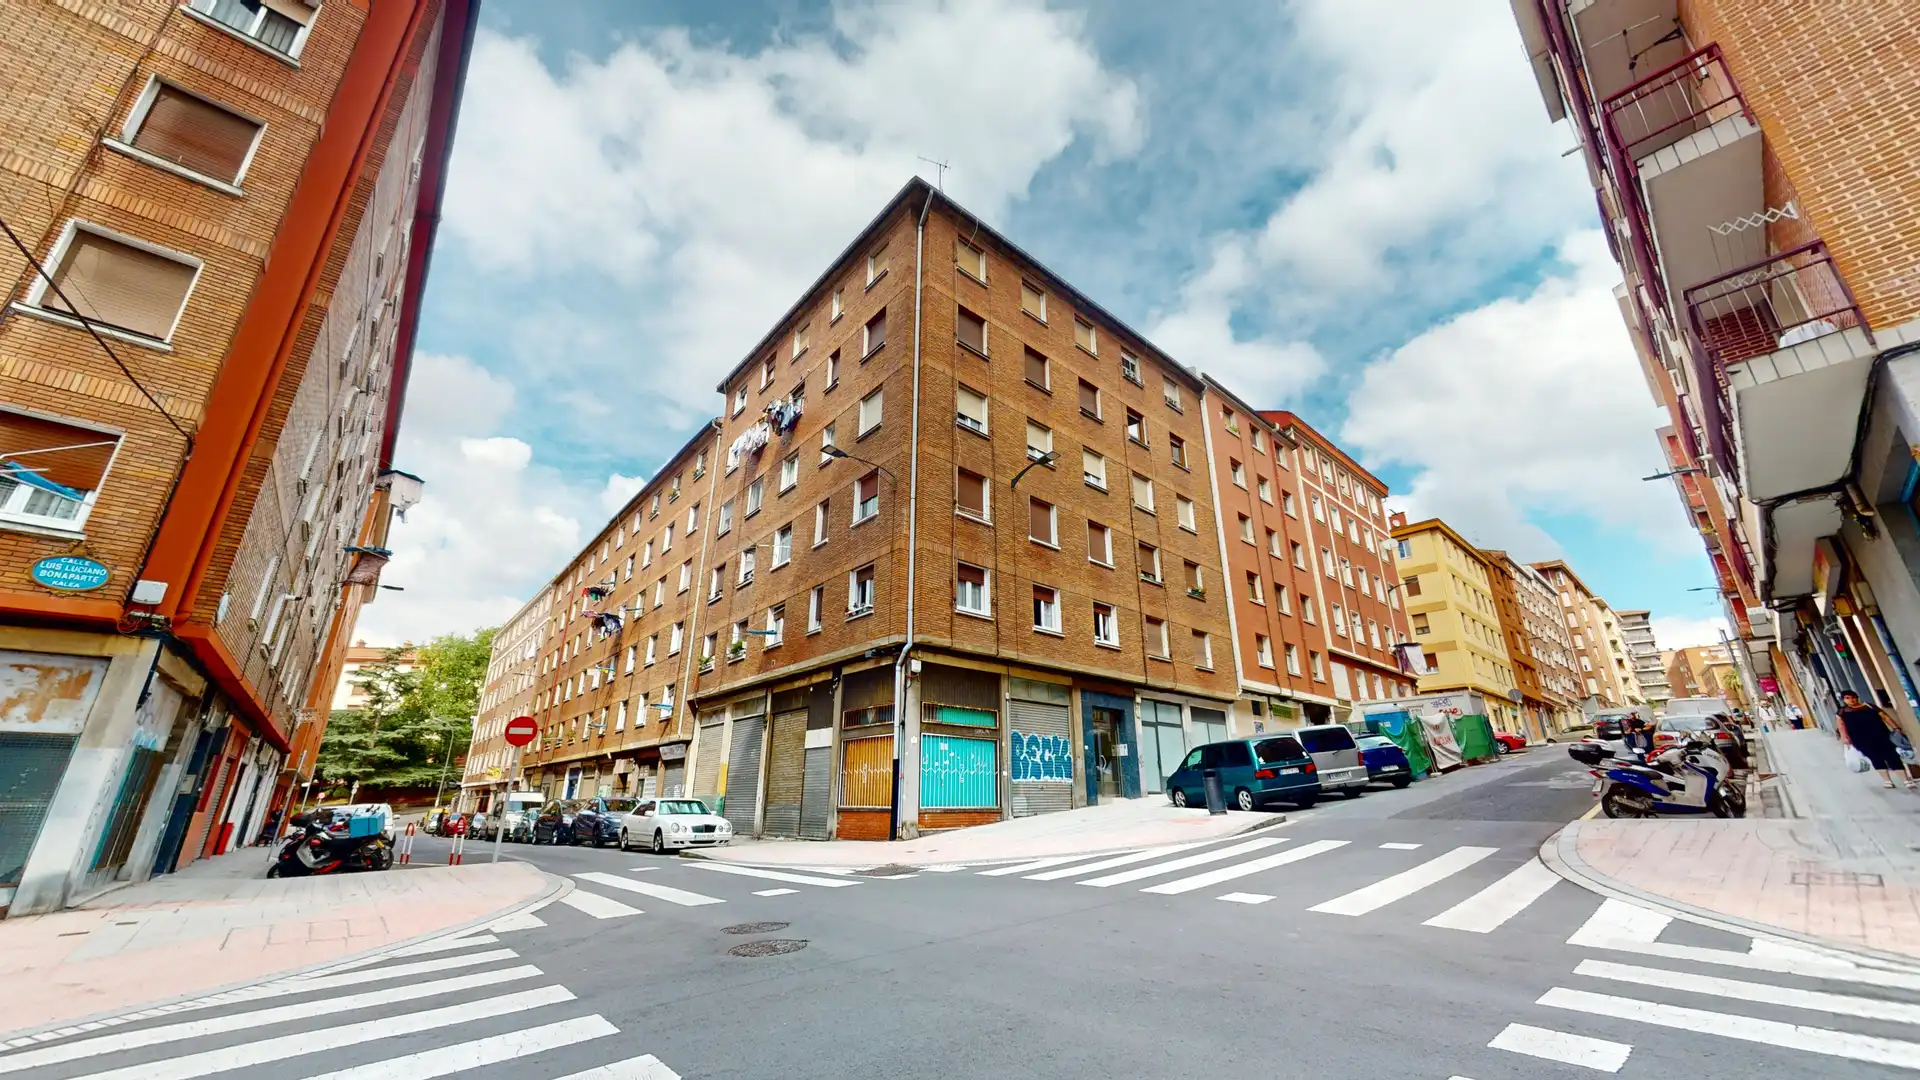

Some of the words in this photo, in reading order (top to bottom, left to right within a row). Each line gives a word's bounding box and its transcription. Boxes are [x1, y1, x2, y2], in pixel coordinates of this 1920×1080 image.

[61, 557, 91, 566] CALLE
[39, 561, 62, 570] LUIS
[65, 565, 107, 576] LUCIANO
[39, 570, 99, 583] BONAPARTE
[52, 580, 80, 588] KALEA
